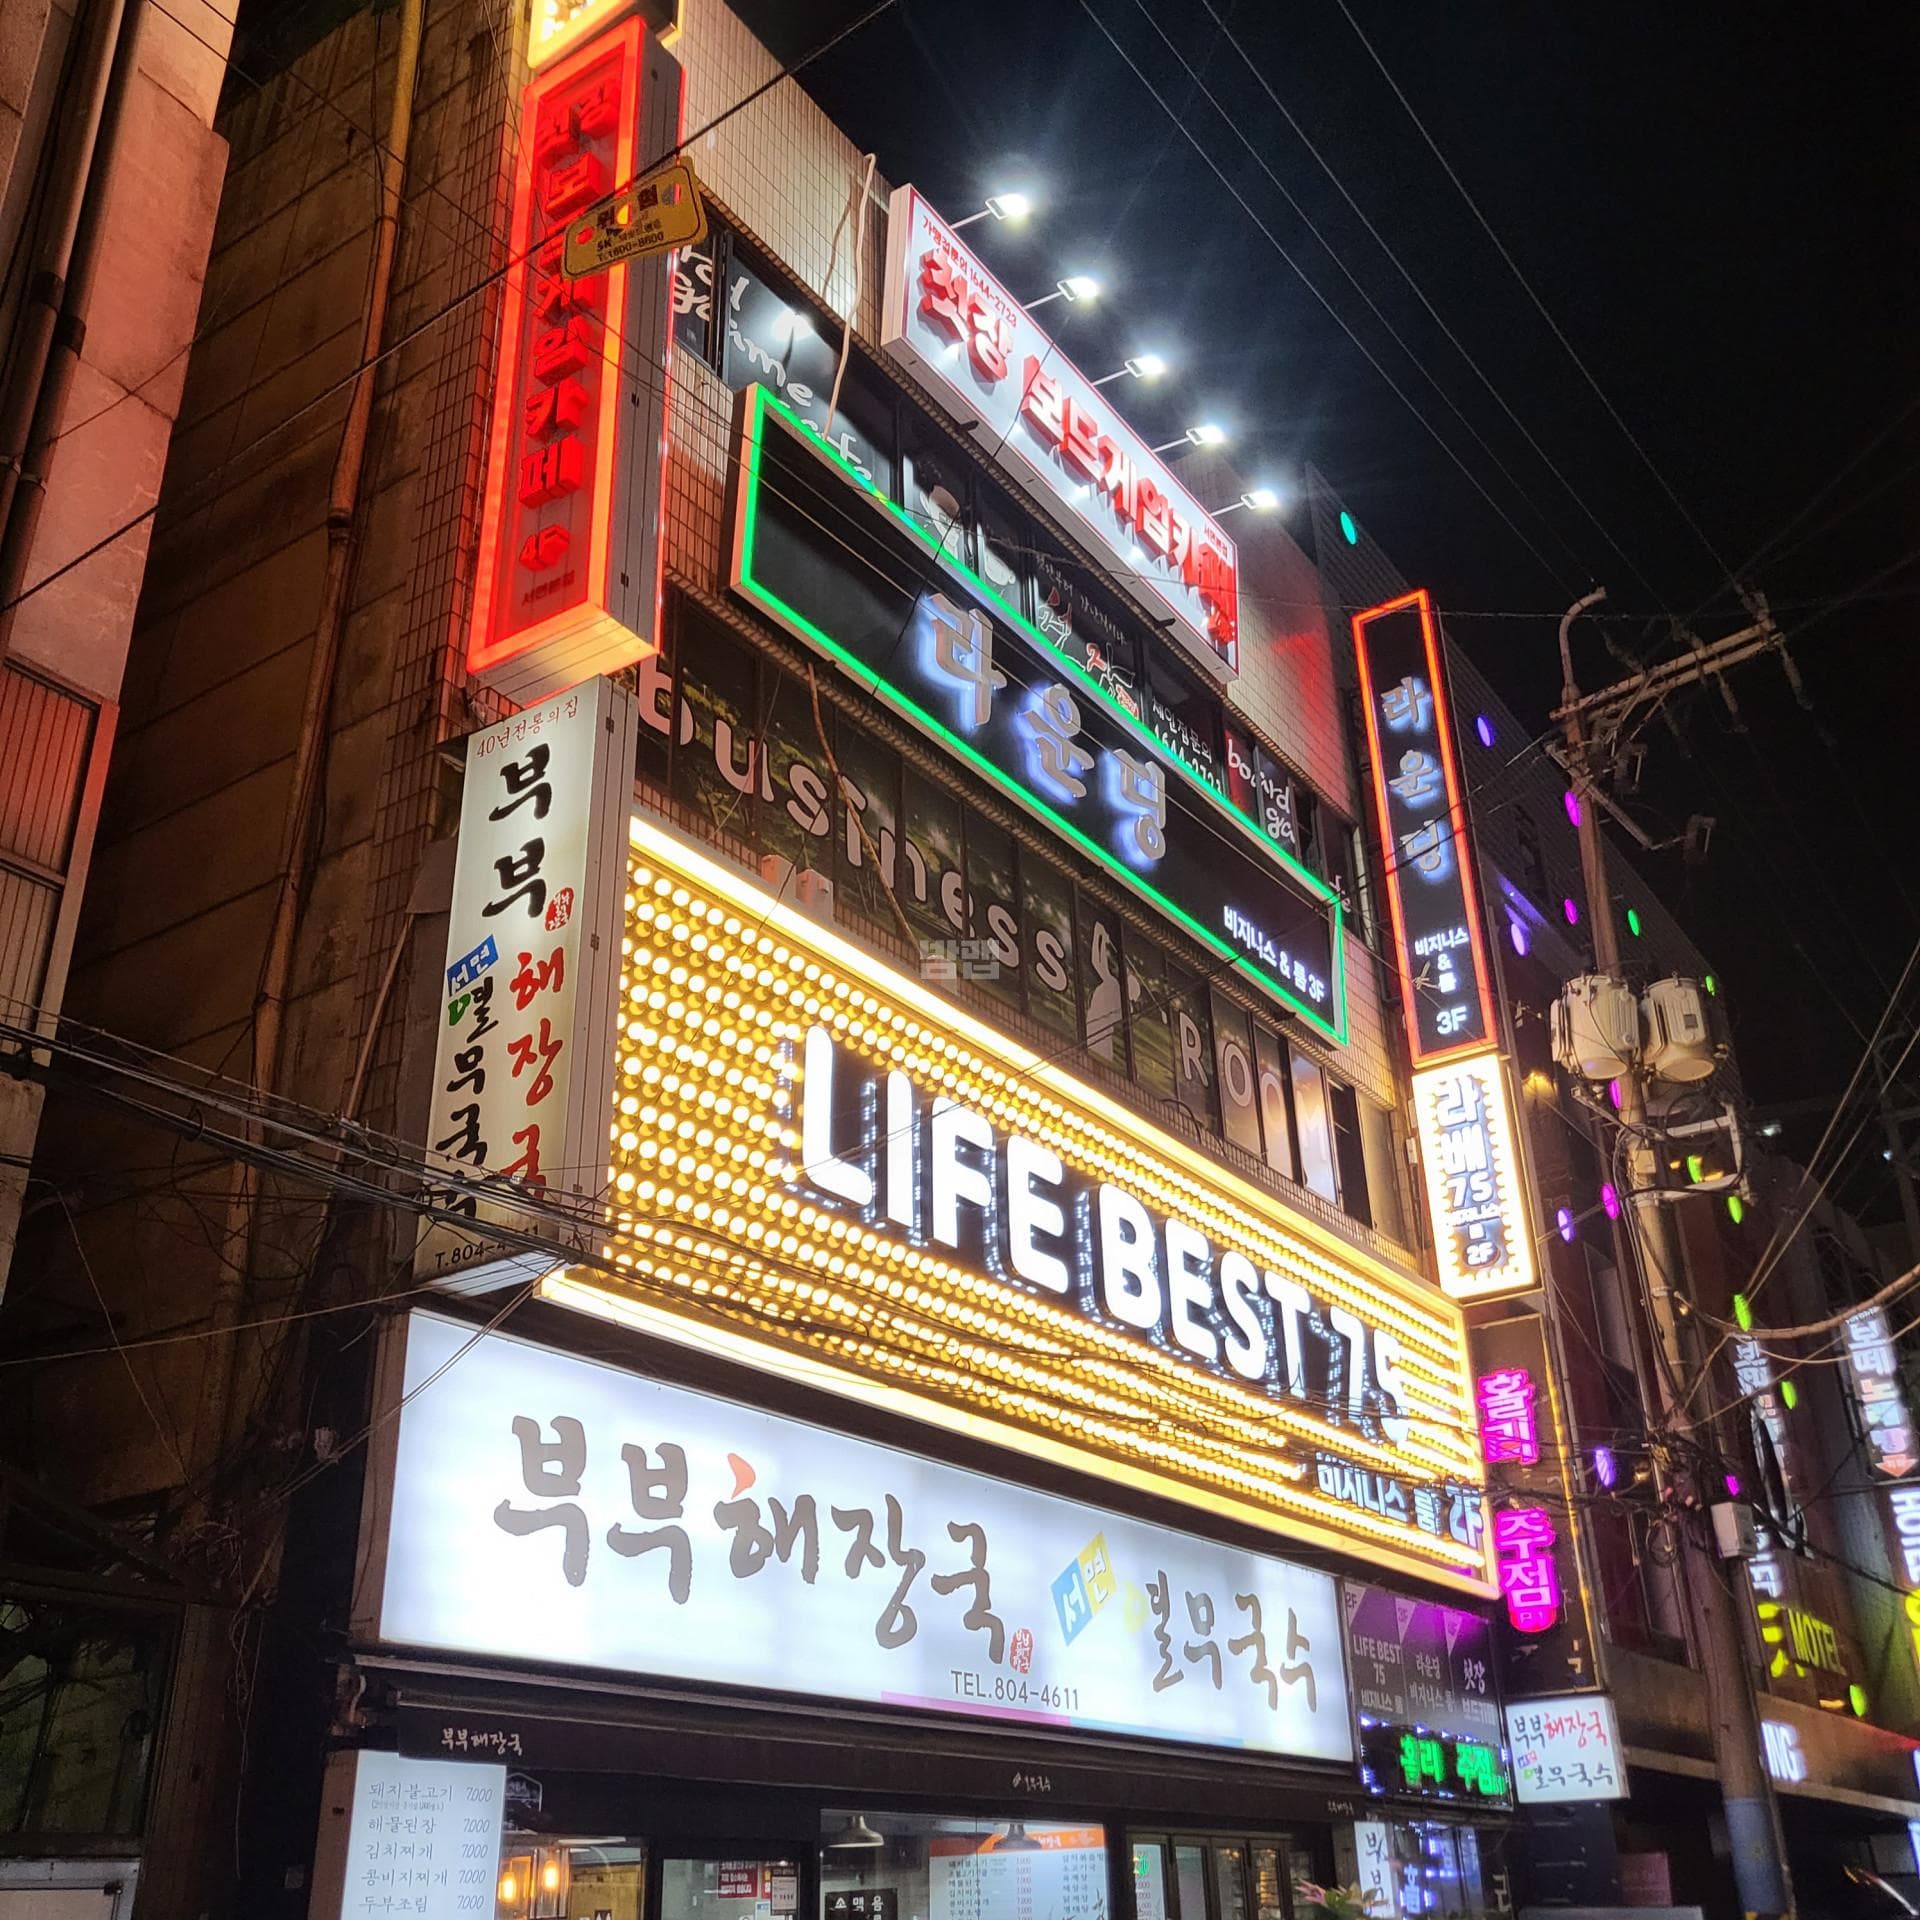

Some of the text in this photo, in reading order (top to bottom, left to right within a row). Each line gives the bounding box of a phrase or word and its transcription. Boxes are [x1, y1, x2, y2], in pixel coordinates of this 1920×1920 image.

[482, 742, 552, 919] 부부
[638, 650, 1068, 993] business
[1224, 905, 1277, 967] 비지니스
[1279, 951, 1291, 979] &
[1308, 973, 1325, 1003] 3F
[1415, 928, 1469, 956] 비지니스
[1437, 953, 1452, 971] &
[1436, 1006, 1467, 1034] 3F
[1447, 1172, 1494, 1207] 75
[802, 1025, 1411, 1444] LIFE BEST 75
[493, 1415, 1005, 1663] 부부해장국
[1501, 1512, 1552, 1608] 주점
[1353, 1634, 1401, 1665] LIFE BEST
[1373, 1662, 1386, 1685] 75
[950, 1670, 1079, 1711] TEL.804-4611
[441, 1727, 523, 1756] 부부해장국
[367, 1815, 437, 1834] 해물된장
[365, 1842, 433, 1861] 김치찌개
[361, 1869, 448, 1888] 콩비지찌개
[358, 1895, 428, 1914] 두부조림
